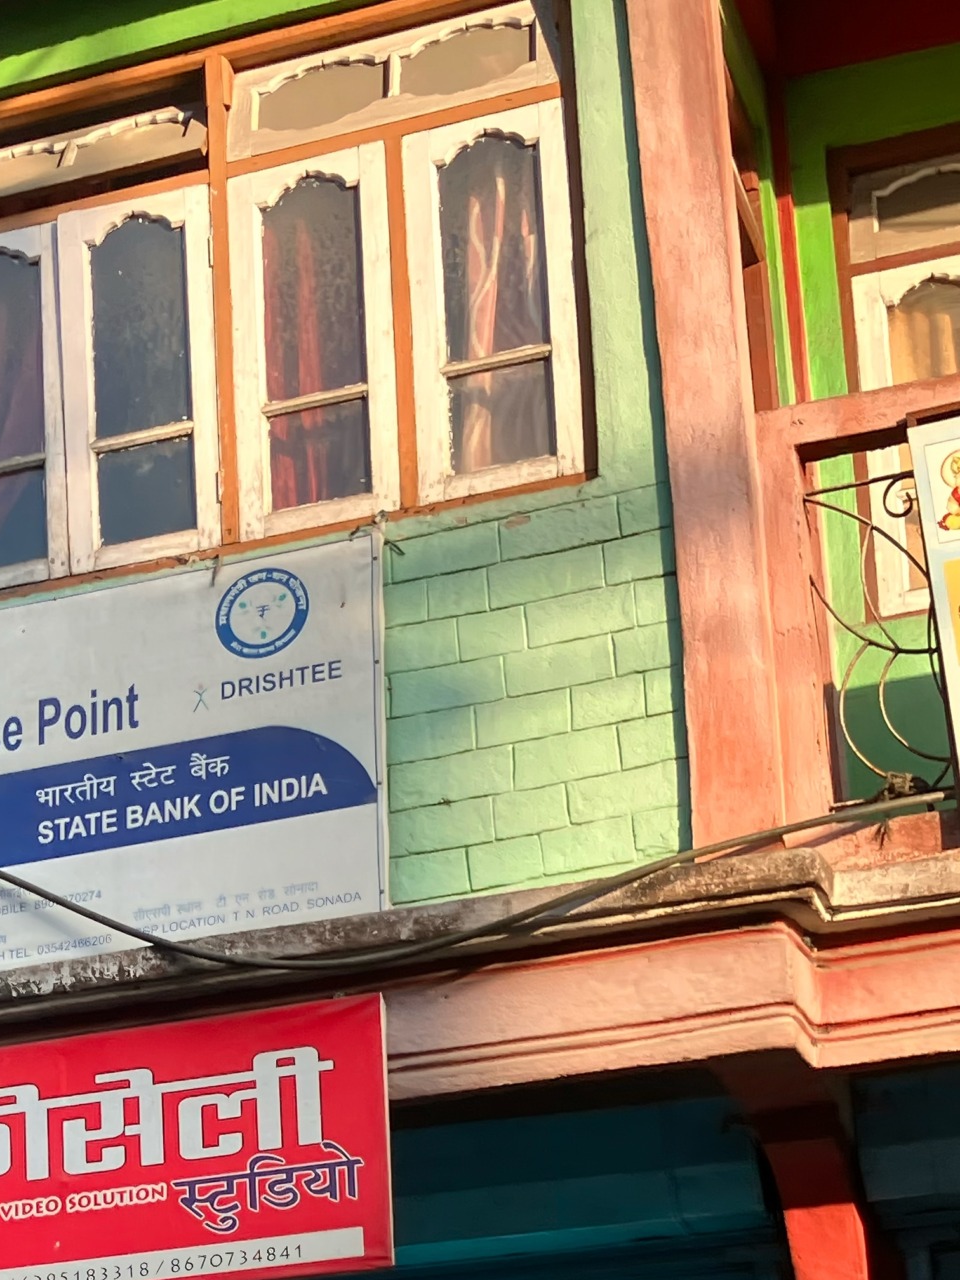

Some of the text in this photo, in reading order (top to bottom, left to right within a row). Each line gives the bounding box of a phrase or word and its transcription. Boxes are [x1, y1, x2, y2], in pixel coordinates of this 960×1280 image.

[221, 660, 343, 700] DRISHTEE
[38, 683, 139, 746] Point
[36, 753, 230, 808] भारतीय स्टेट बैंक
[37, 772, 328, 844] STATE BANK OF INDIA
[162, 914, 225, 934] LOCATION
[306, 891, 362, 910] SONADA
[66, 1183, 167, 1213] SOLUTION
[173, 1140, 364, 1234] स्टुडियो
